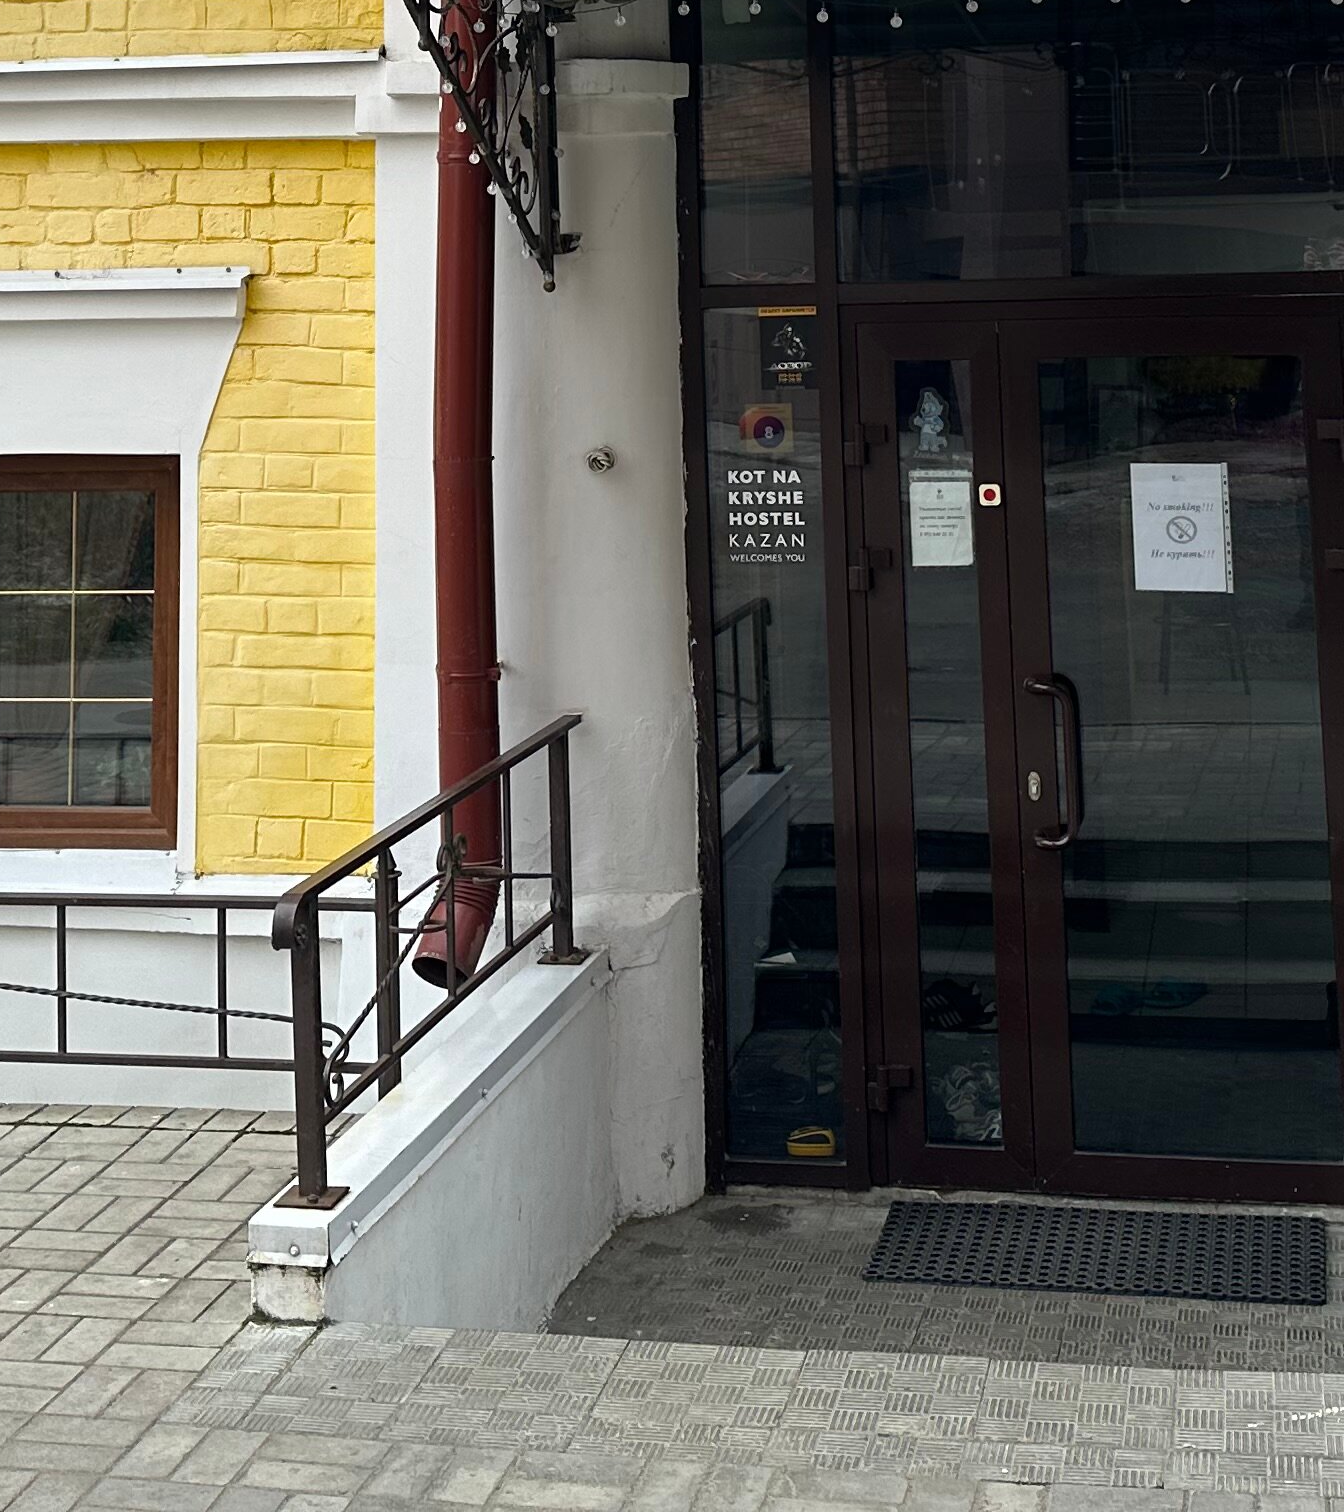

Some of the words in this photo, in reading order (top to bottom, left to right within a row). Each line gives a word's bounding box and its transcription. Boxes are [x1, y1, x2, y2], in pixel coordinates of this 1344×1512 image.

[727, 470, 766, 484] KOT
[772, 470, 801, 484] NA
[728, 491, 804, 505] KRYSHE
[1146, 501, 1161, 512] No
[1163, 501, 1214, 513] smoking!!!
[729, 512, 806, 526] HOSTEL
[729, 533, 805, 548] KAZAN
[729, 553, 783, 563] WELCOMES
[785, 553, 806, 563] YOU
[1150, 548, 1165, 559] Не
